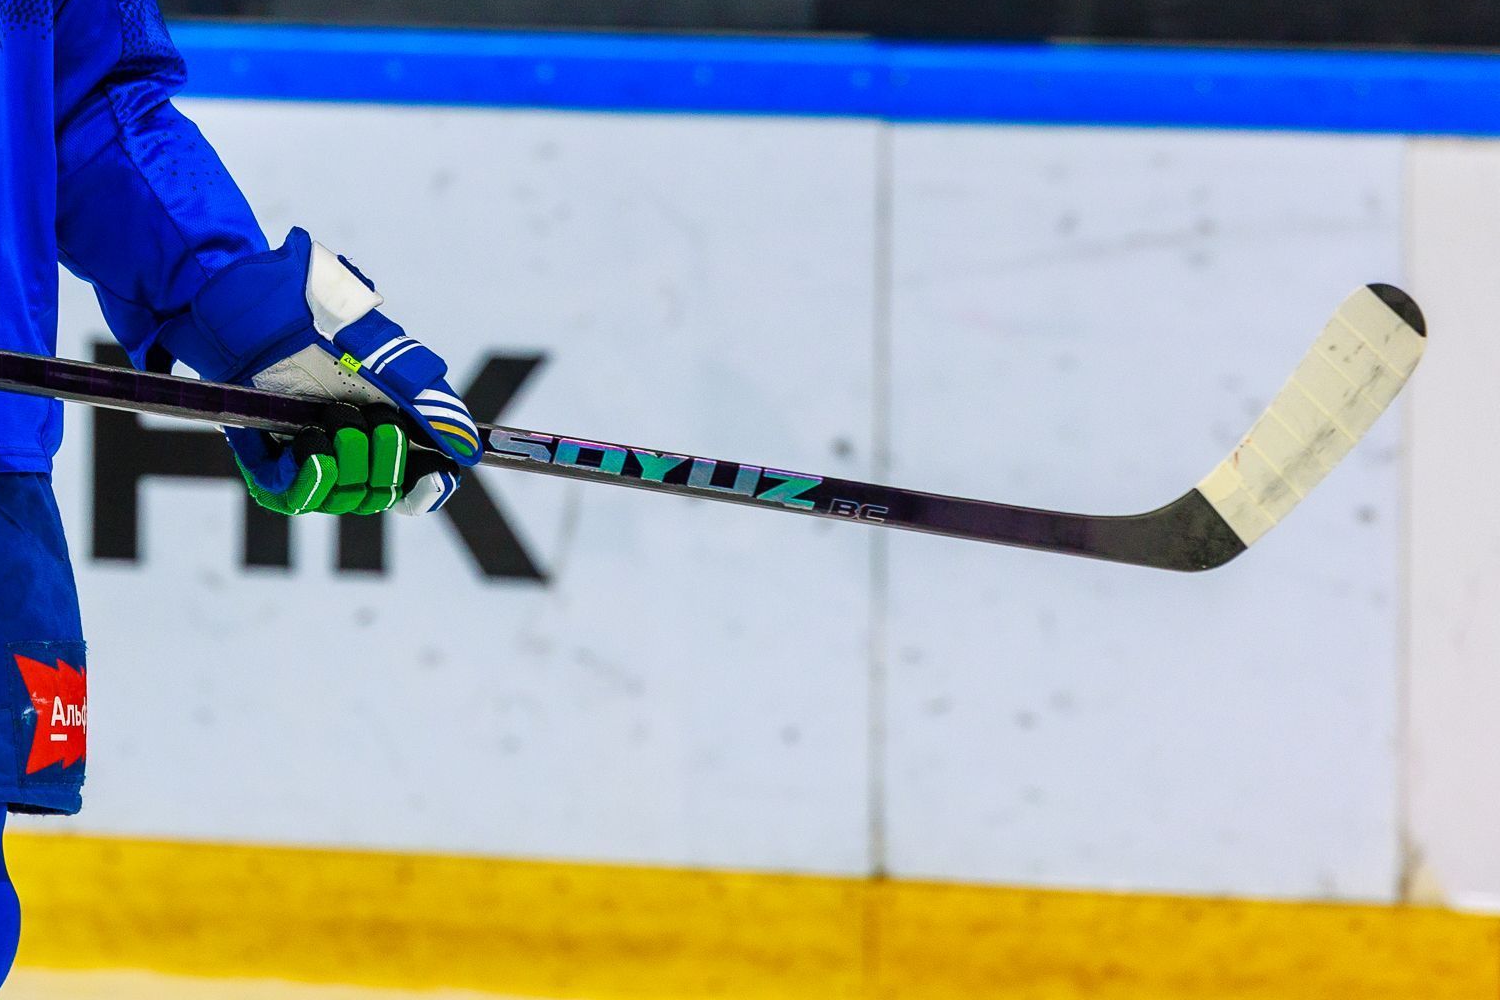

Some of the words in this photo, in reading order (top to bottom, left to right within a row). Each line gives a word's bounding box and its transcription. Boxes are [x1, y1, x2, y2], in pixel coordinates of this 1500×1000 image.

[488, 429, 824, 511] SOYUZ
[828, 498, 890, 524] BC
[50, 696, 87, 735] Альф
